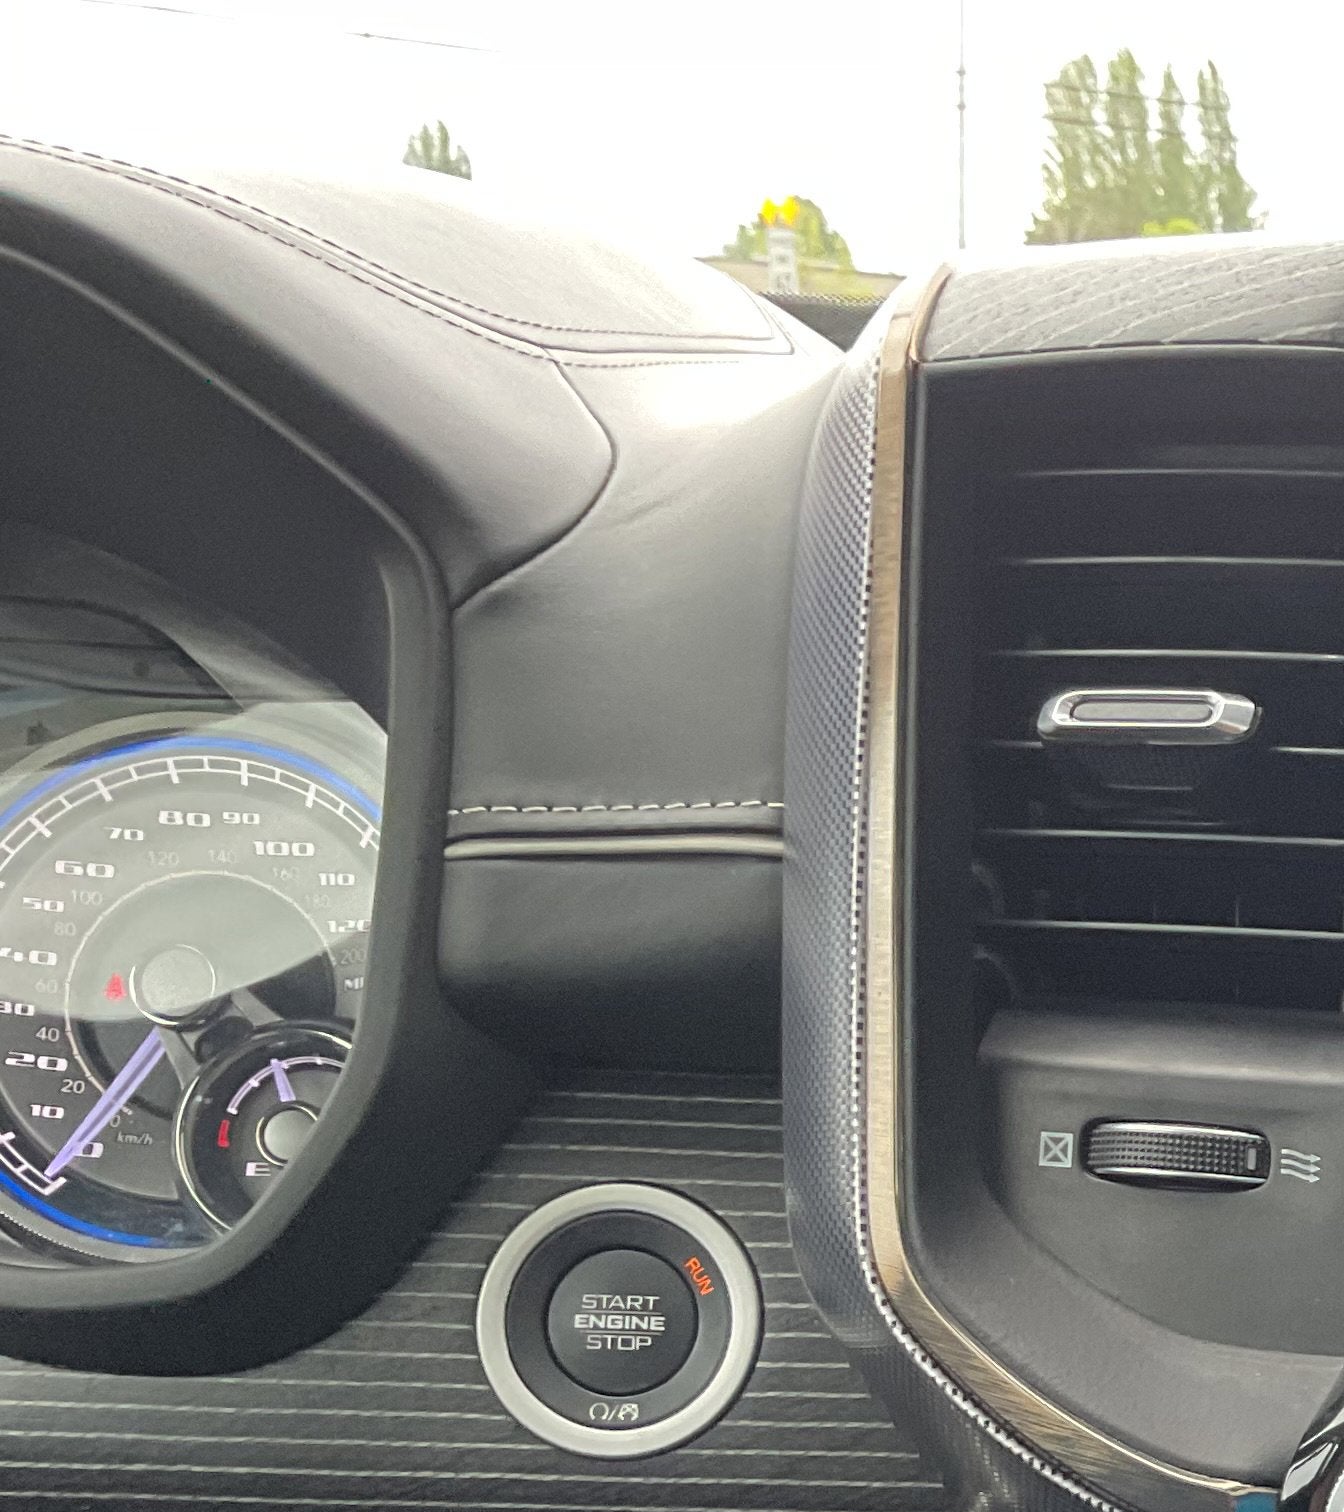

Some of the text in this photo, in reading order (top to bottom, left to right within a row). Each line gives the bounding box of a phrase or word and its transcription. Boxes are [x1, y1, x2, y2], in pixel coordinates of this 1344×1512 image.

[159, 810, 261, 827] 80 90
[104, 827, 145, 842] 70
[253, 841, 316, 857] 100
[55, 860, 115, 879] 60
[319, 873, 355, 886] 110
[23, 897, 64, 913] 50
[35, 1028, 60, 1042] 40
[5, 1052, 68, 1072] 20
[60, 1079, 86, 1095] 20
[30, 1105, 64, 1119] 10
[117, 1131, 153, 1146] km/h
[245, 1162, 271, 1177] E
[684, 1257, 714, 1295] RUN
[581, 1294, 660, 1310] START
[574, 1314, 665, 1331] ENGINE
[586, 1335, 652, 1350] STOP
